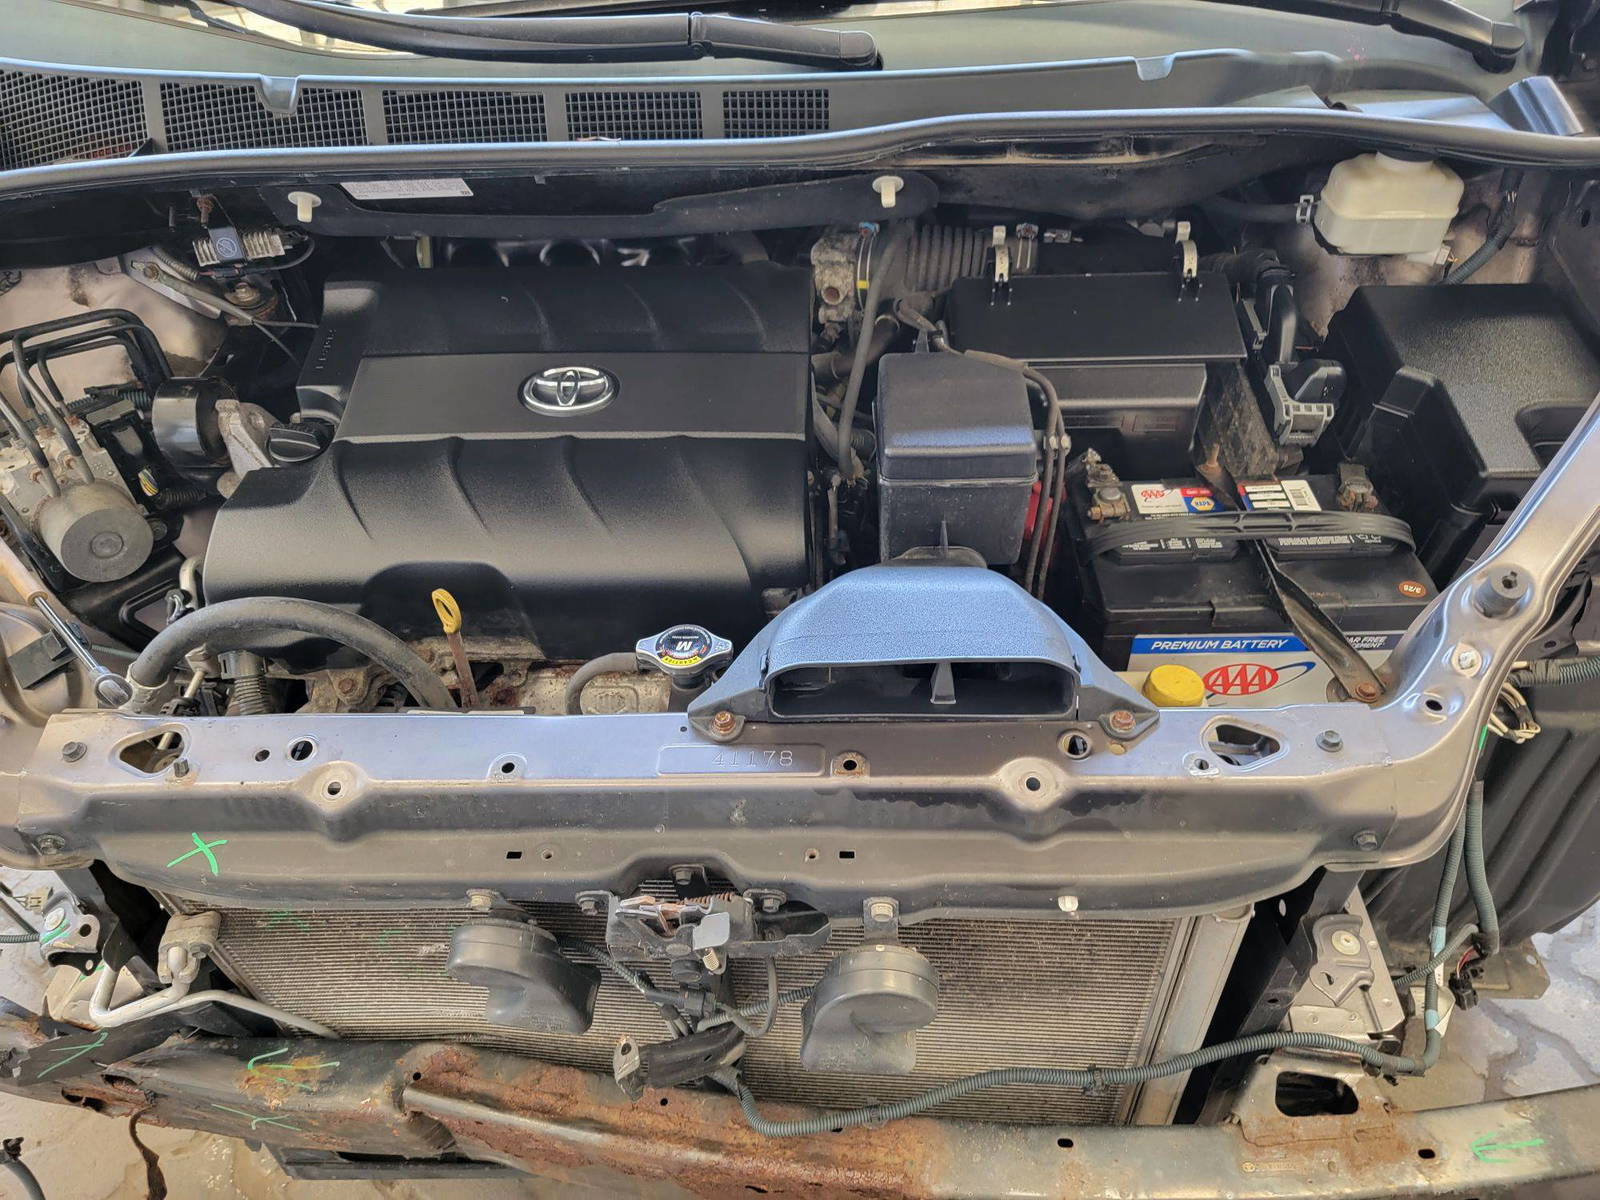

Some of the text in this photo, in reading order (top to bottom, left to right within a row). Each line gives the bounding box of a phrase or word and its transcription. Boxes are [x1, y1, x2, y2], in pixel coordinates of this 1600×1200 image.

[1151, 639, 1288, 650] PREMIUM BATTERY
[1361, 635, 1388, 643] FREE
[1206, 664, 1272, 695] AAA
[712, 750, 793, 767] 41178
